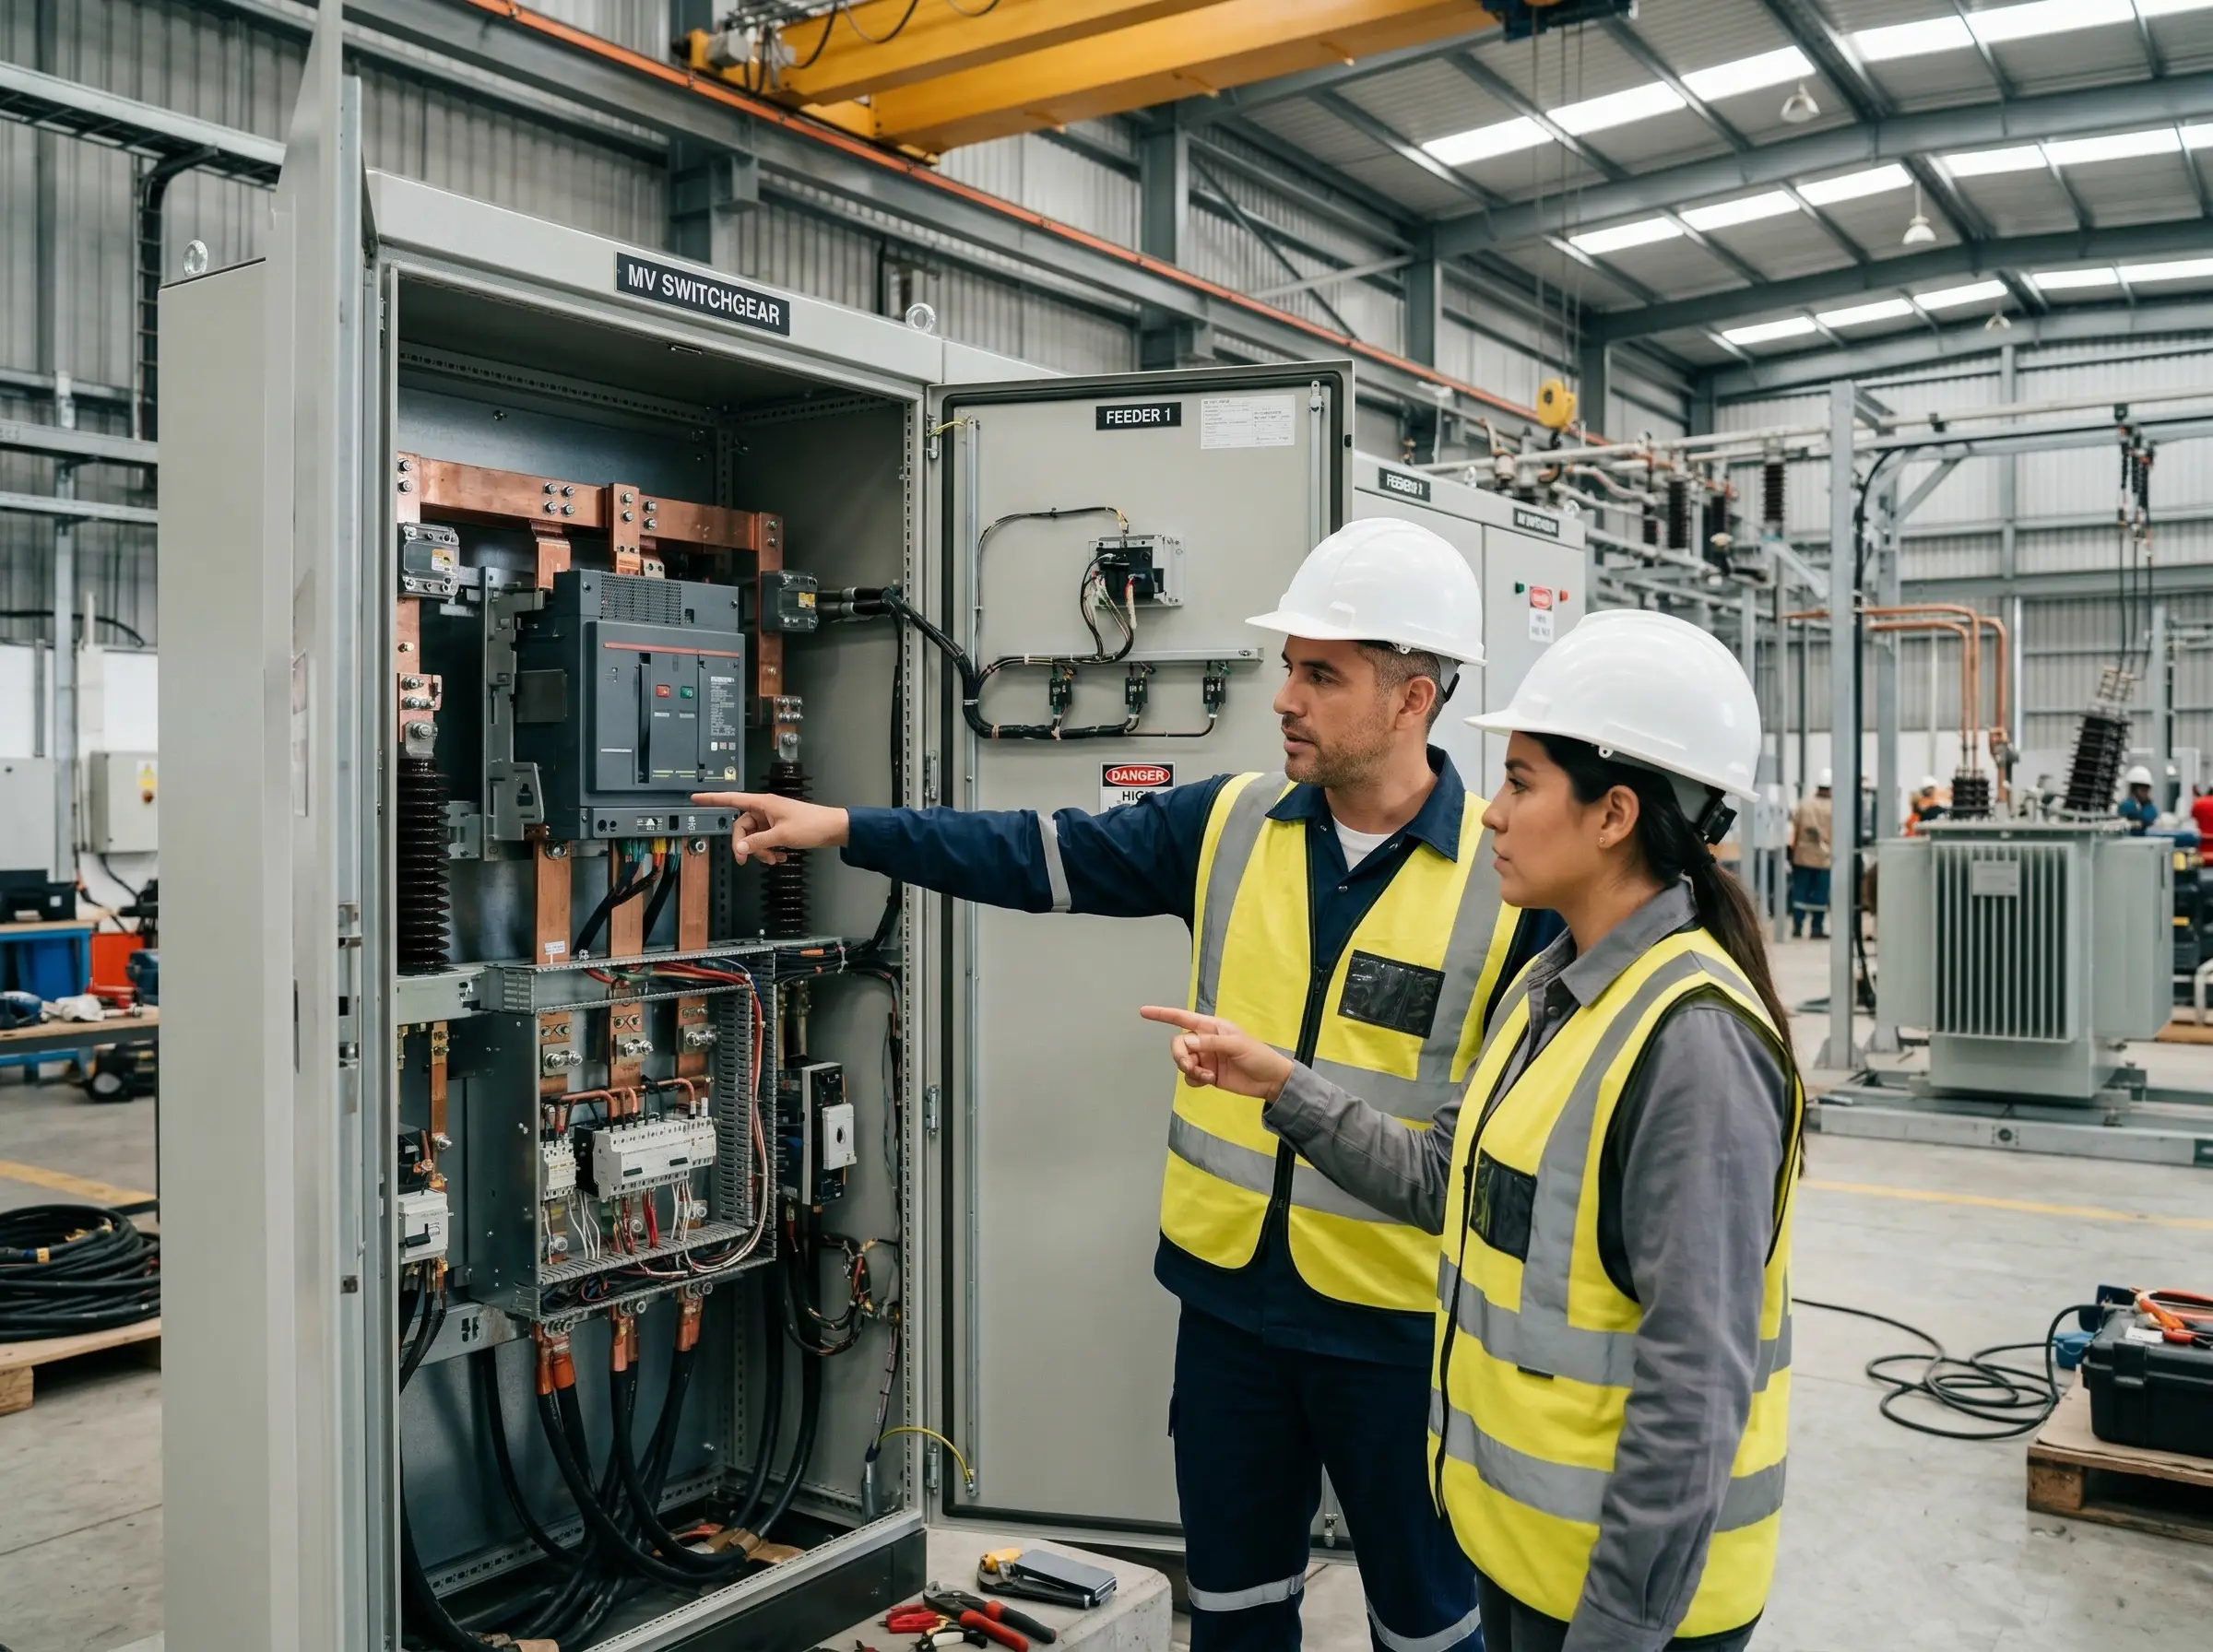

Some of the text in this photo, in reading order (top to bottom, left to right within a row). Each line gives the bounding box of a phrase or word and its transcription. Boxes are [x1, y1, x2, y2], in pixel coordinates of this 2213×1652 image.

[628, 263, 780, 326] MV SWITCHGEAR
[1106, 407, 1171, 424] FEEDER 1
[1111, 770, 1165, 782] DANGER
[1122, 790, 1144, 801] HIG
